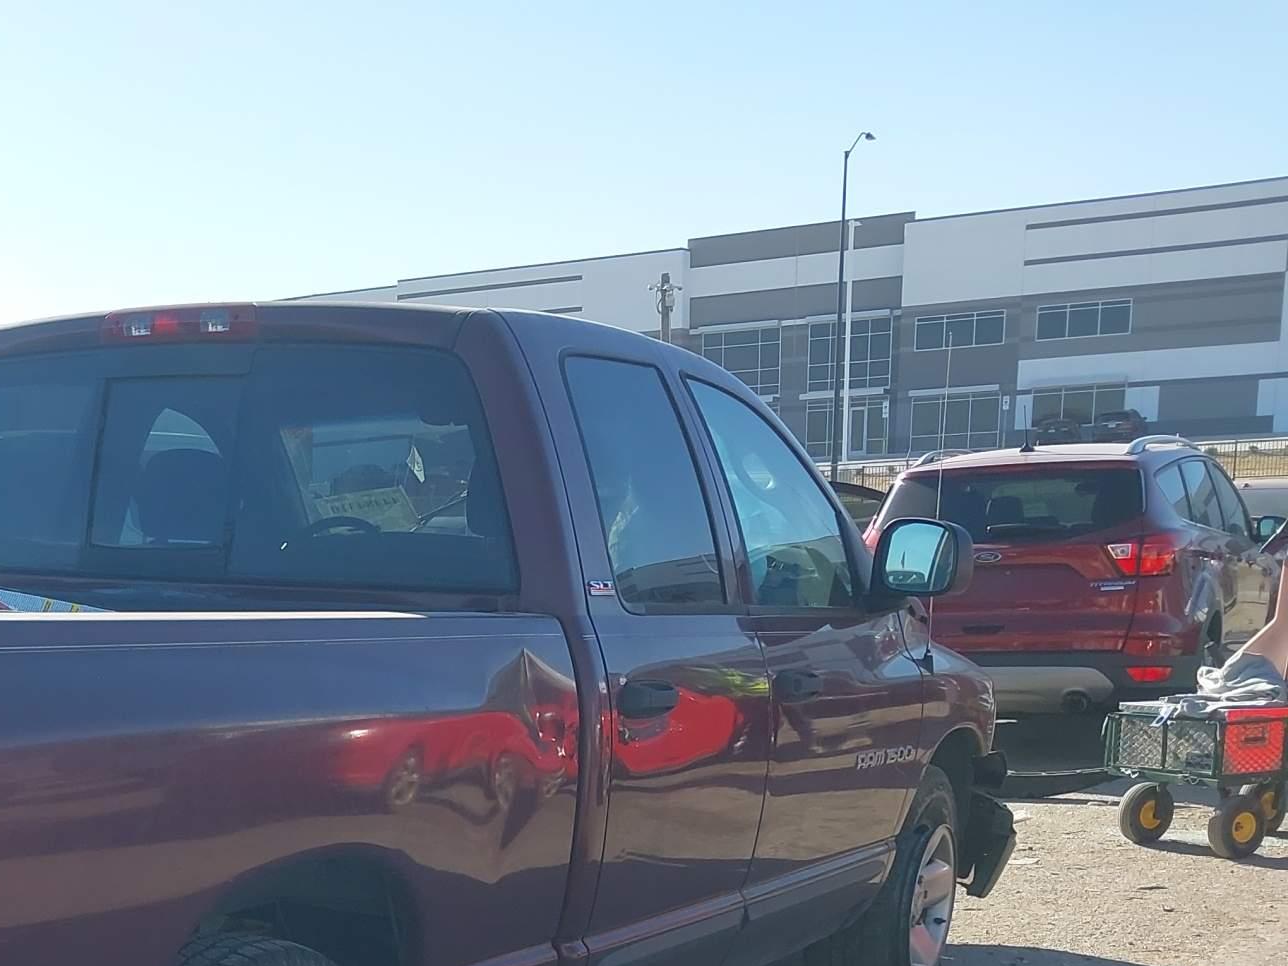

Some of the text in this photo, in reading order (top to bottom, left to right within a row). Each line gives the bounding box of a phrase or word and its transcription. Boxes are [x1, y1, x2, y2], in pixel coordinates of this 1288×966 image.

[590, 580, 613, 590] SLT
[857, 745, 915, 770] RAM 1500
